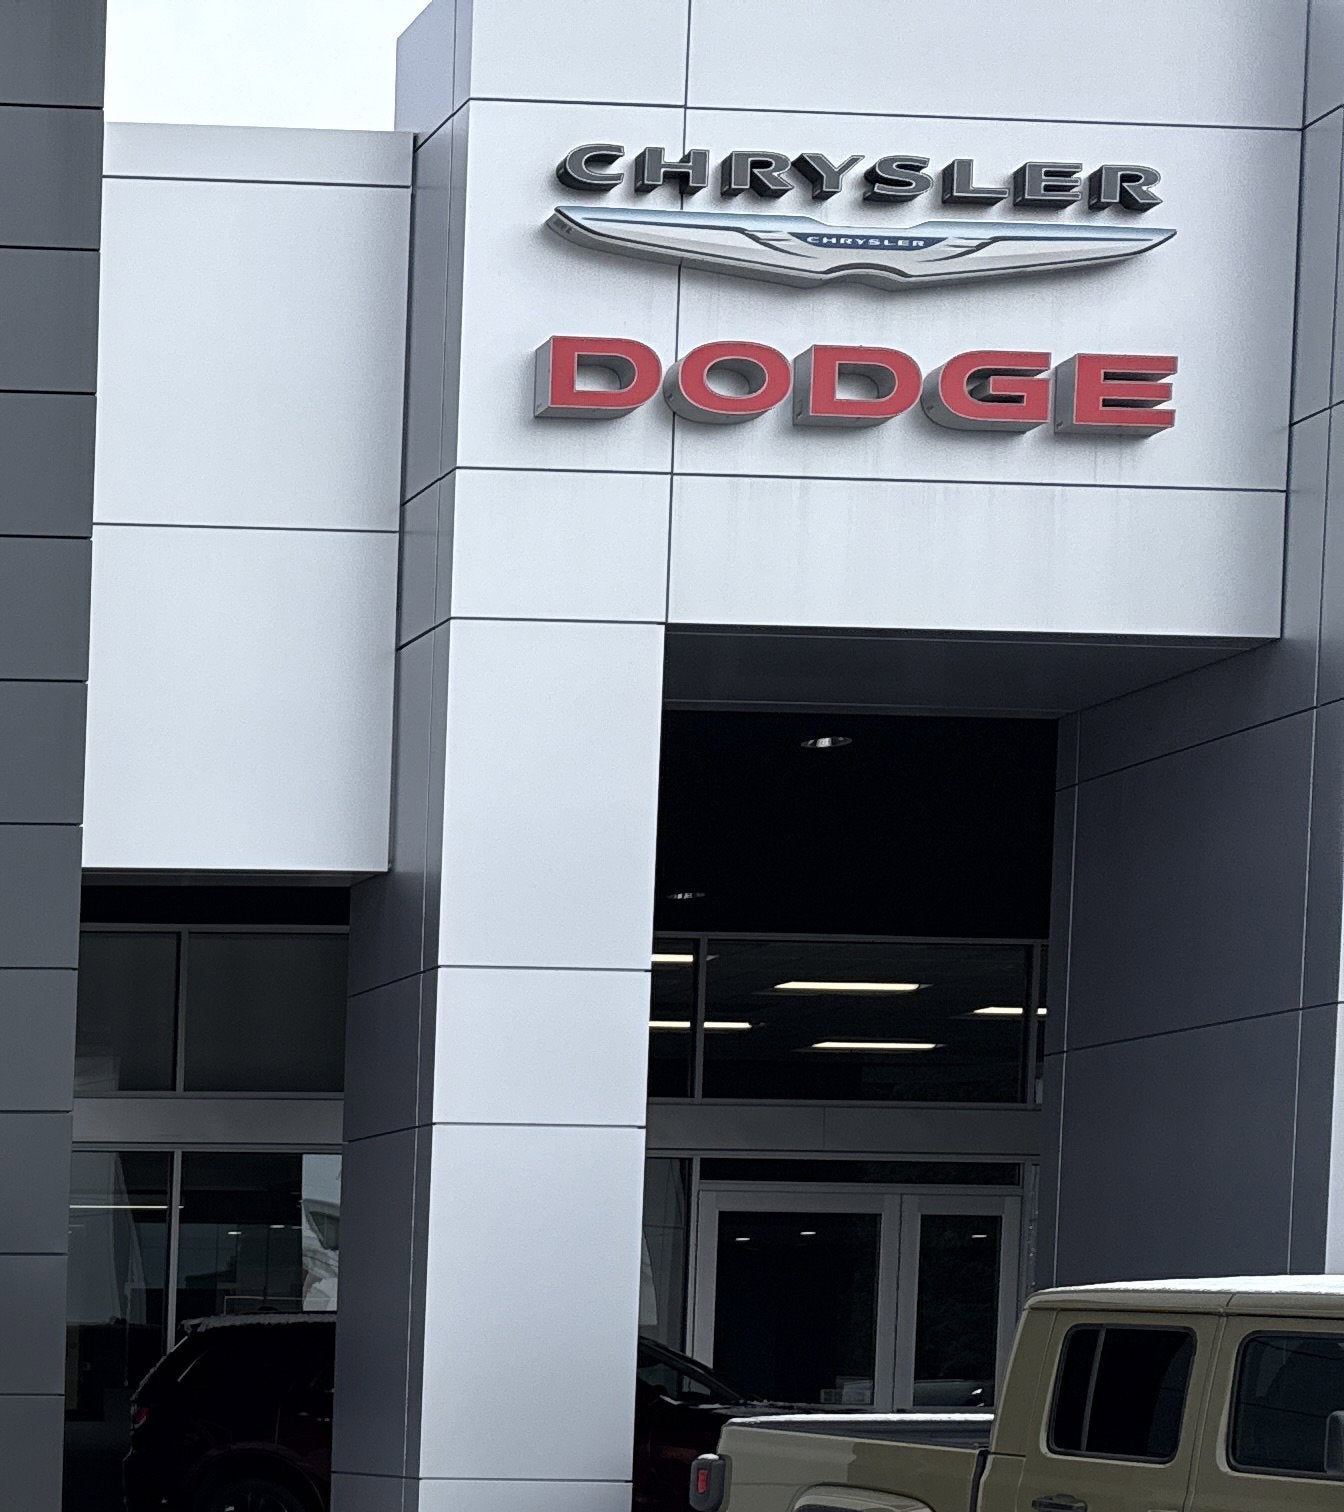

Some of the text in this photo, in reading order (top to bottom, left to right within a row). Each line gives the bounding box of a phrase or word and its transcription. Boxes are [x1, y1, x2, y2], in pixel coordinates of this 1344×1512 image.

[555, 143, 1163, 211] CHRYSLER
[806, 233, 927, 249] CHRYSLER
[534, 335, 1178, 436] DODGE
